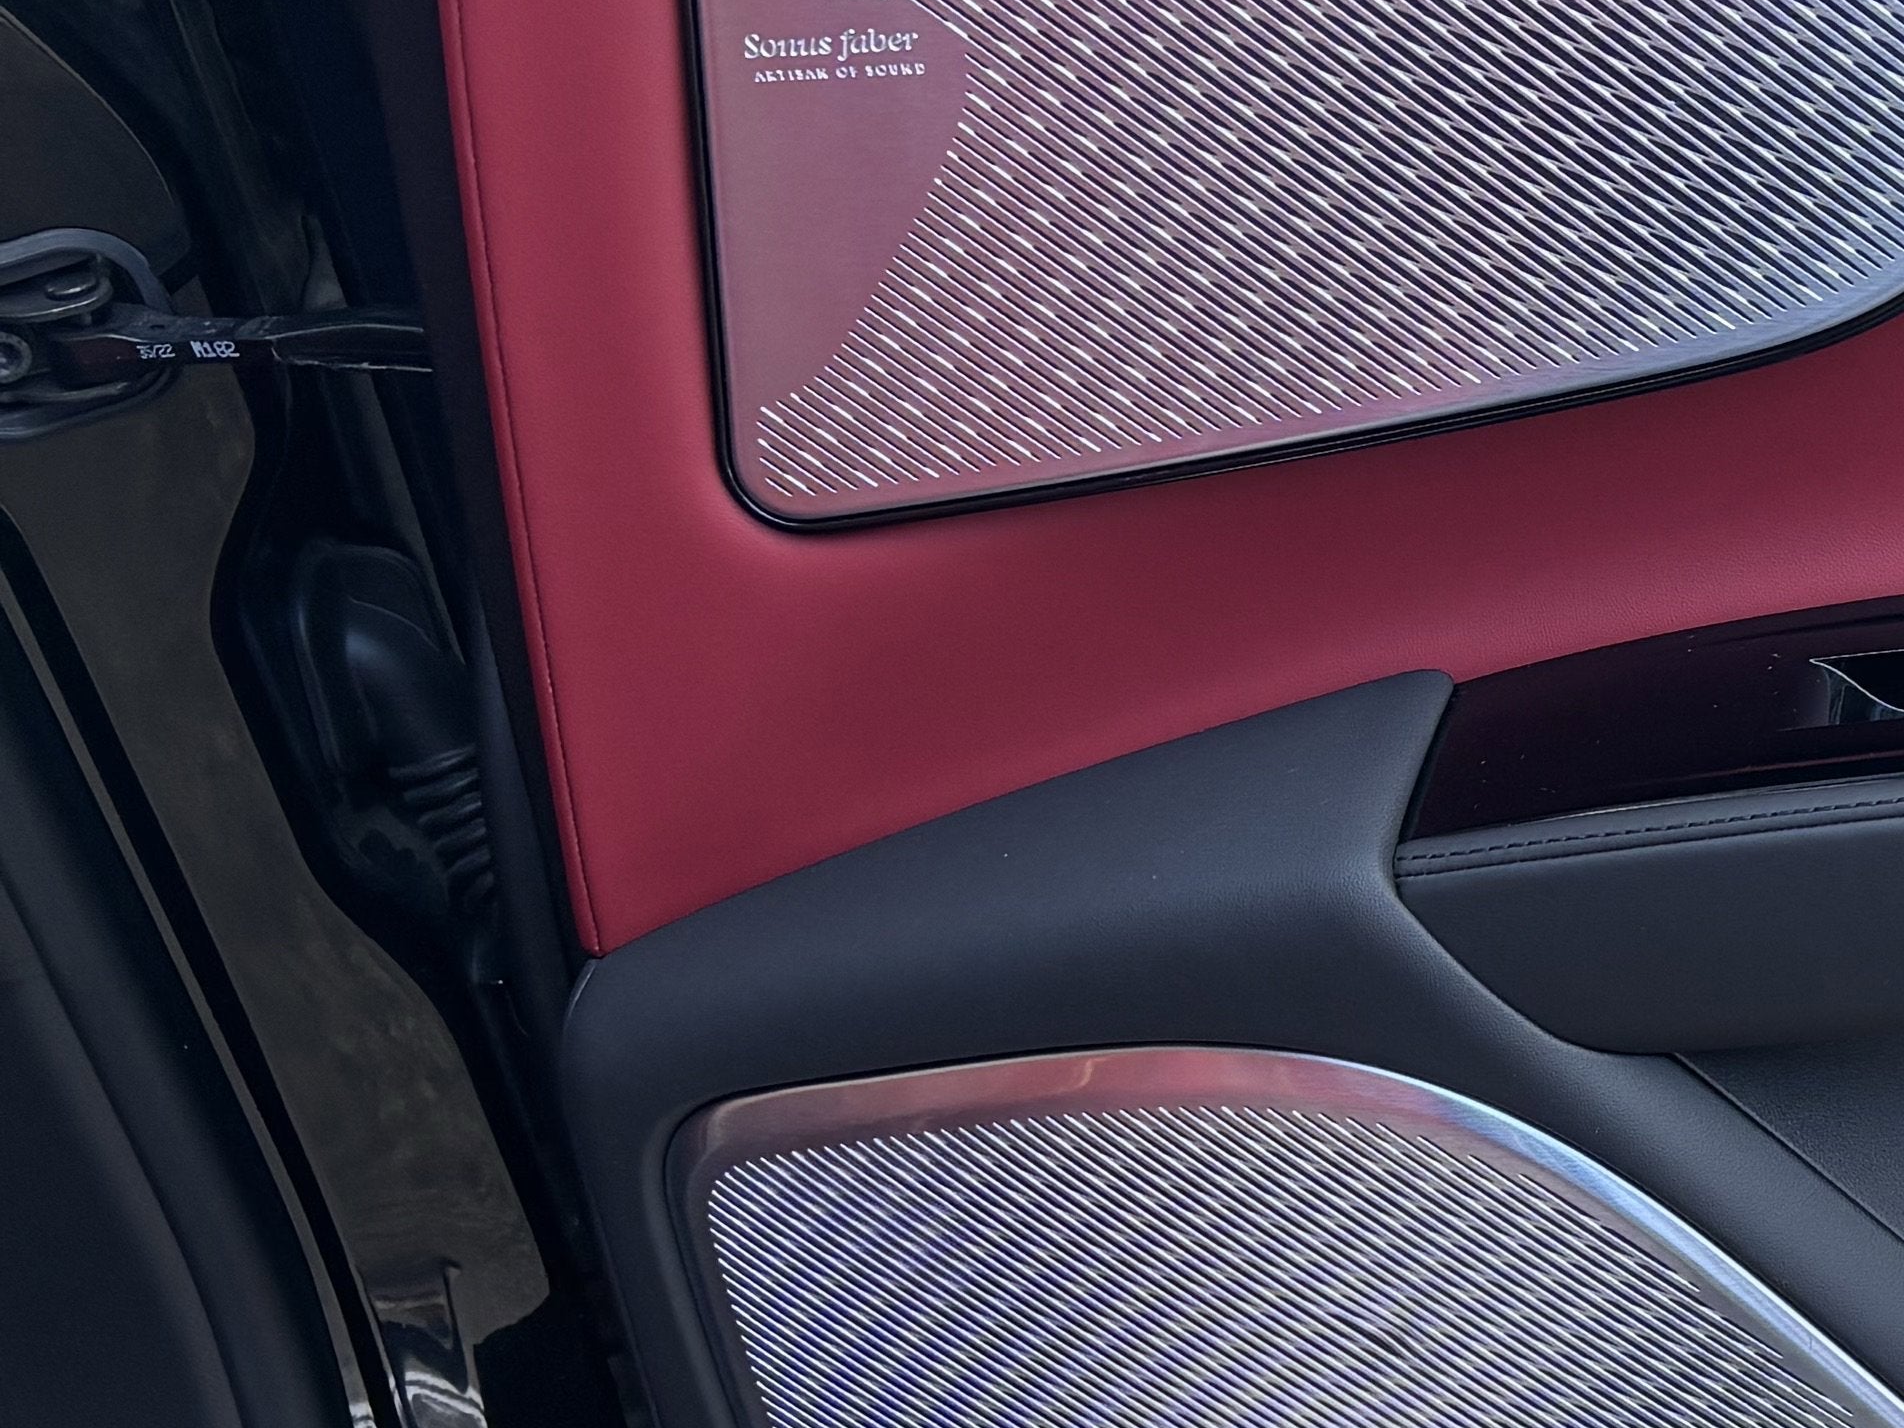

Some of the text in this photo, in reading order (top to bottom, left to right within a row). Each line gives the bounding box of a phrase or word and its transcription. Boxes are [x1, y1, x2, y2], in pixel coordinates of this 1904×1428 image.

[744, 28, 920, 62] Sonus faber
[754, 63, 927, 83] ARTISAN OF SOUND
